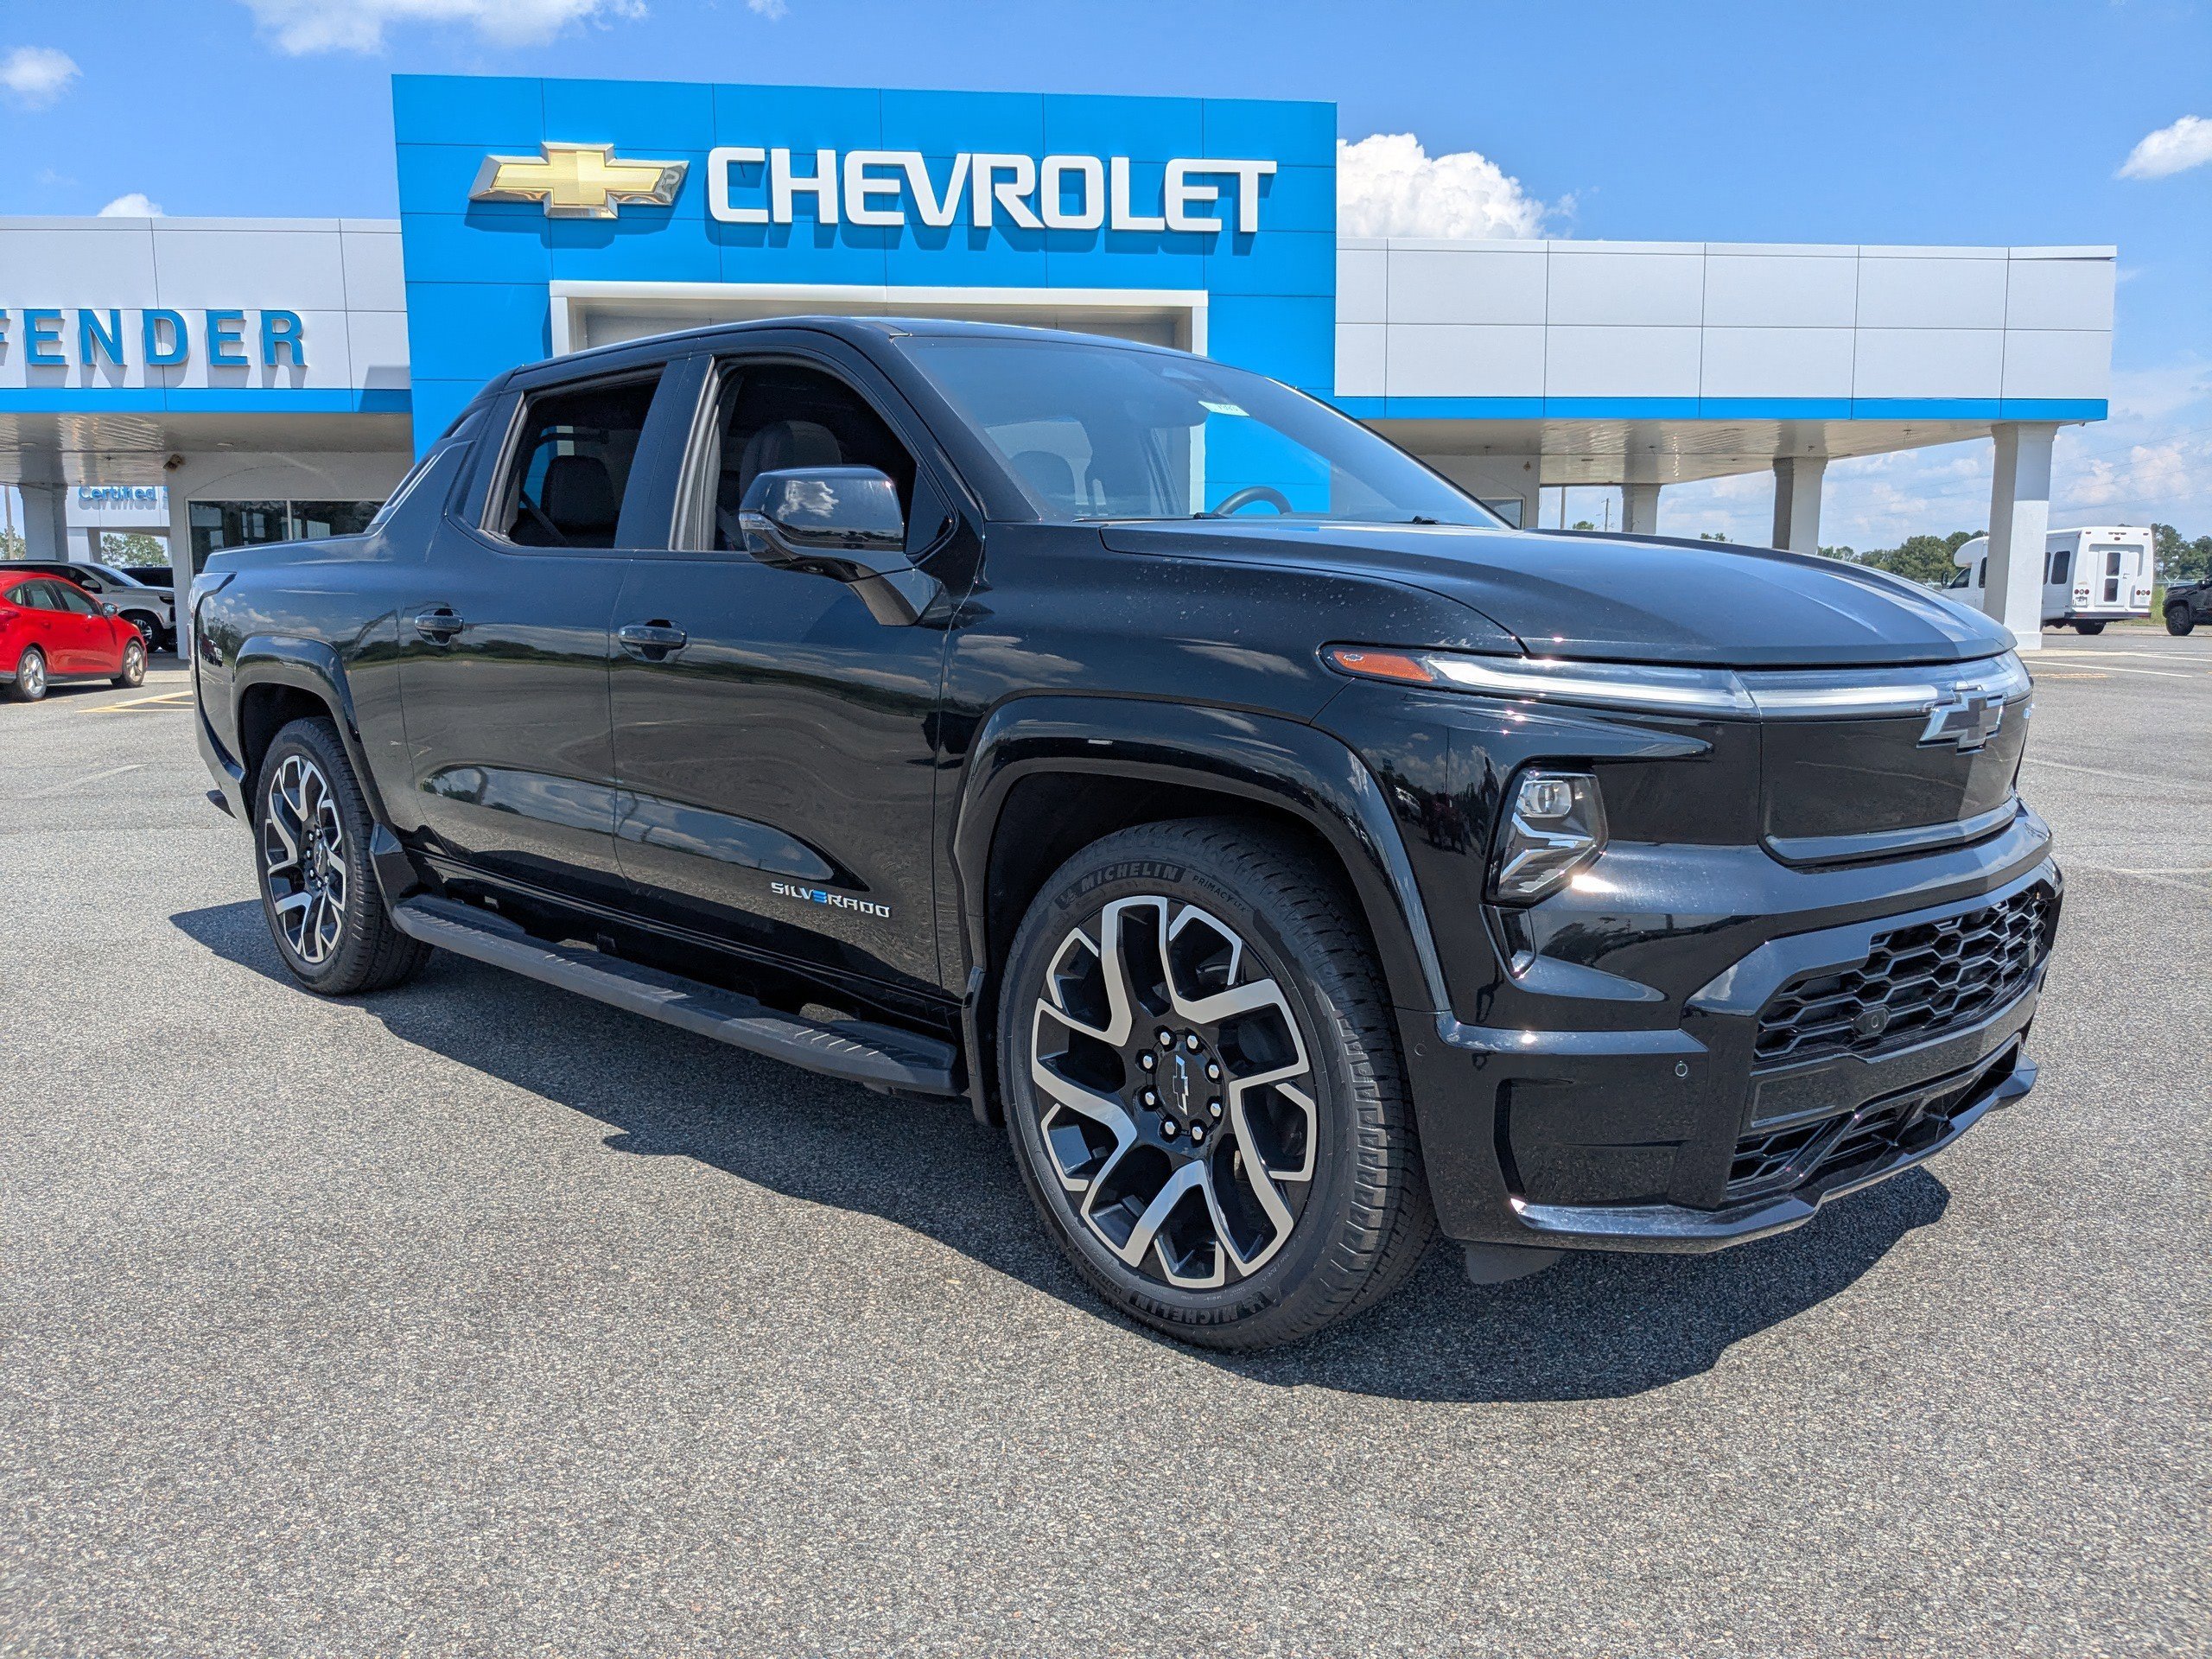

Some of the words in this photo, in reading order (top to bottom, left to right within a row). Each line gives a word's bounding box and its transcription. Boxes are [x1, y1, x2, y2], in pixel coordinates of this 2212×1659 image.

[708, 146, 1277, 233] CHEVROLET
[0, 308, 306, 367] ENDER
[79, 486, 156, 499] Certified
[771, 881, 890, 918] SILVERADO
[1081, 863, 1179, 893] MICHELIN
[1192, 874, 1234, 902] PRIMACY
[1135, 1294, 1238, 1325] MICHELIN
